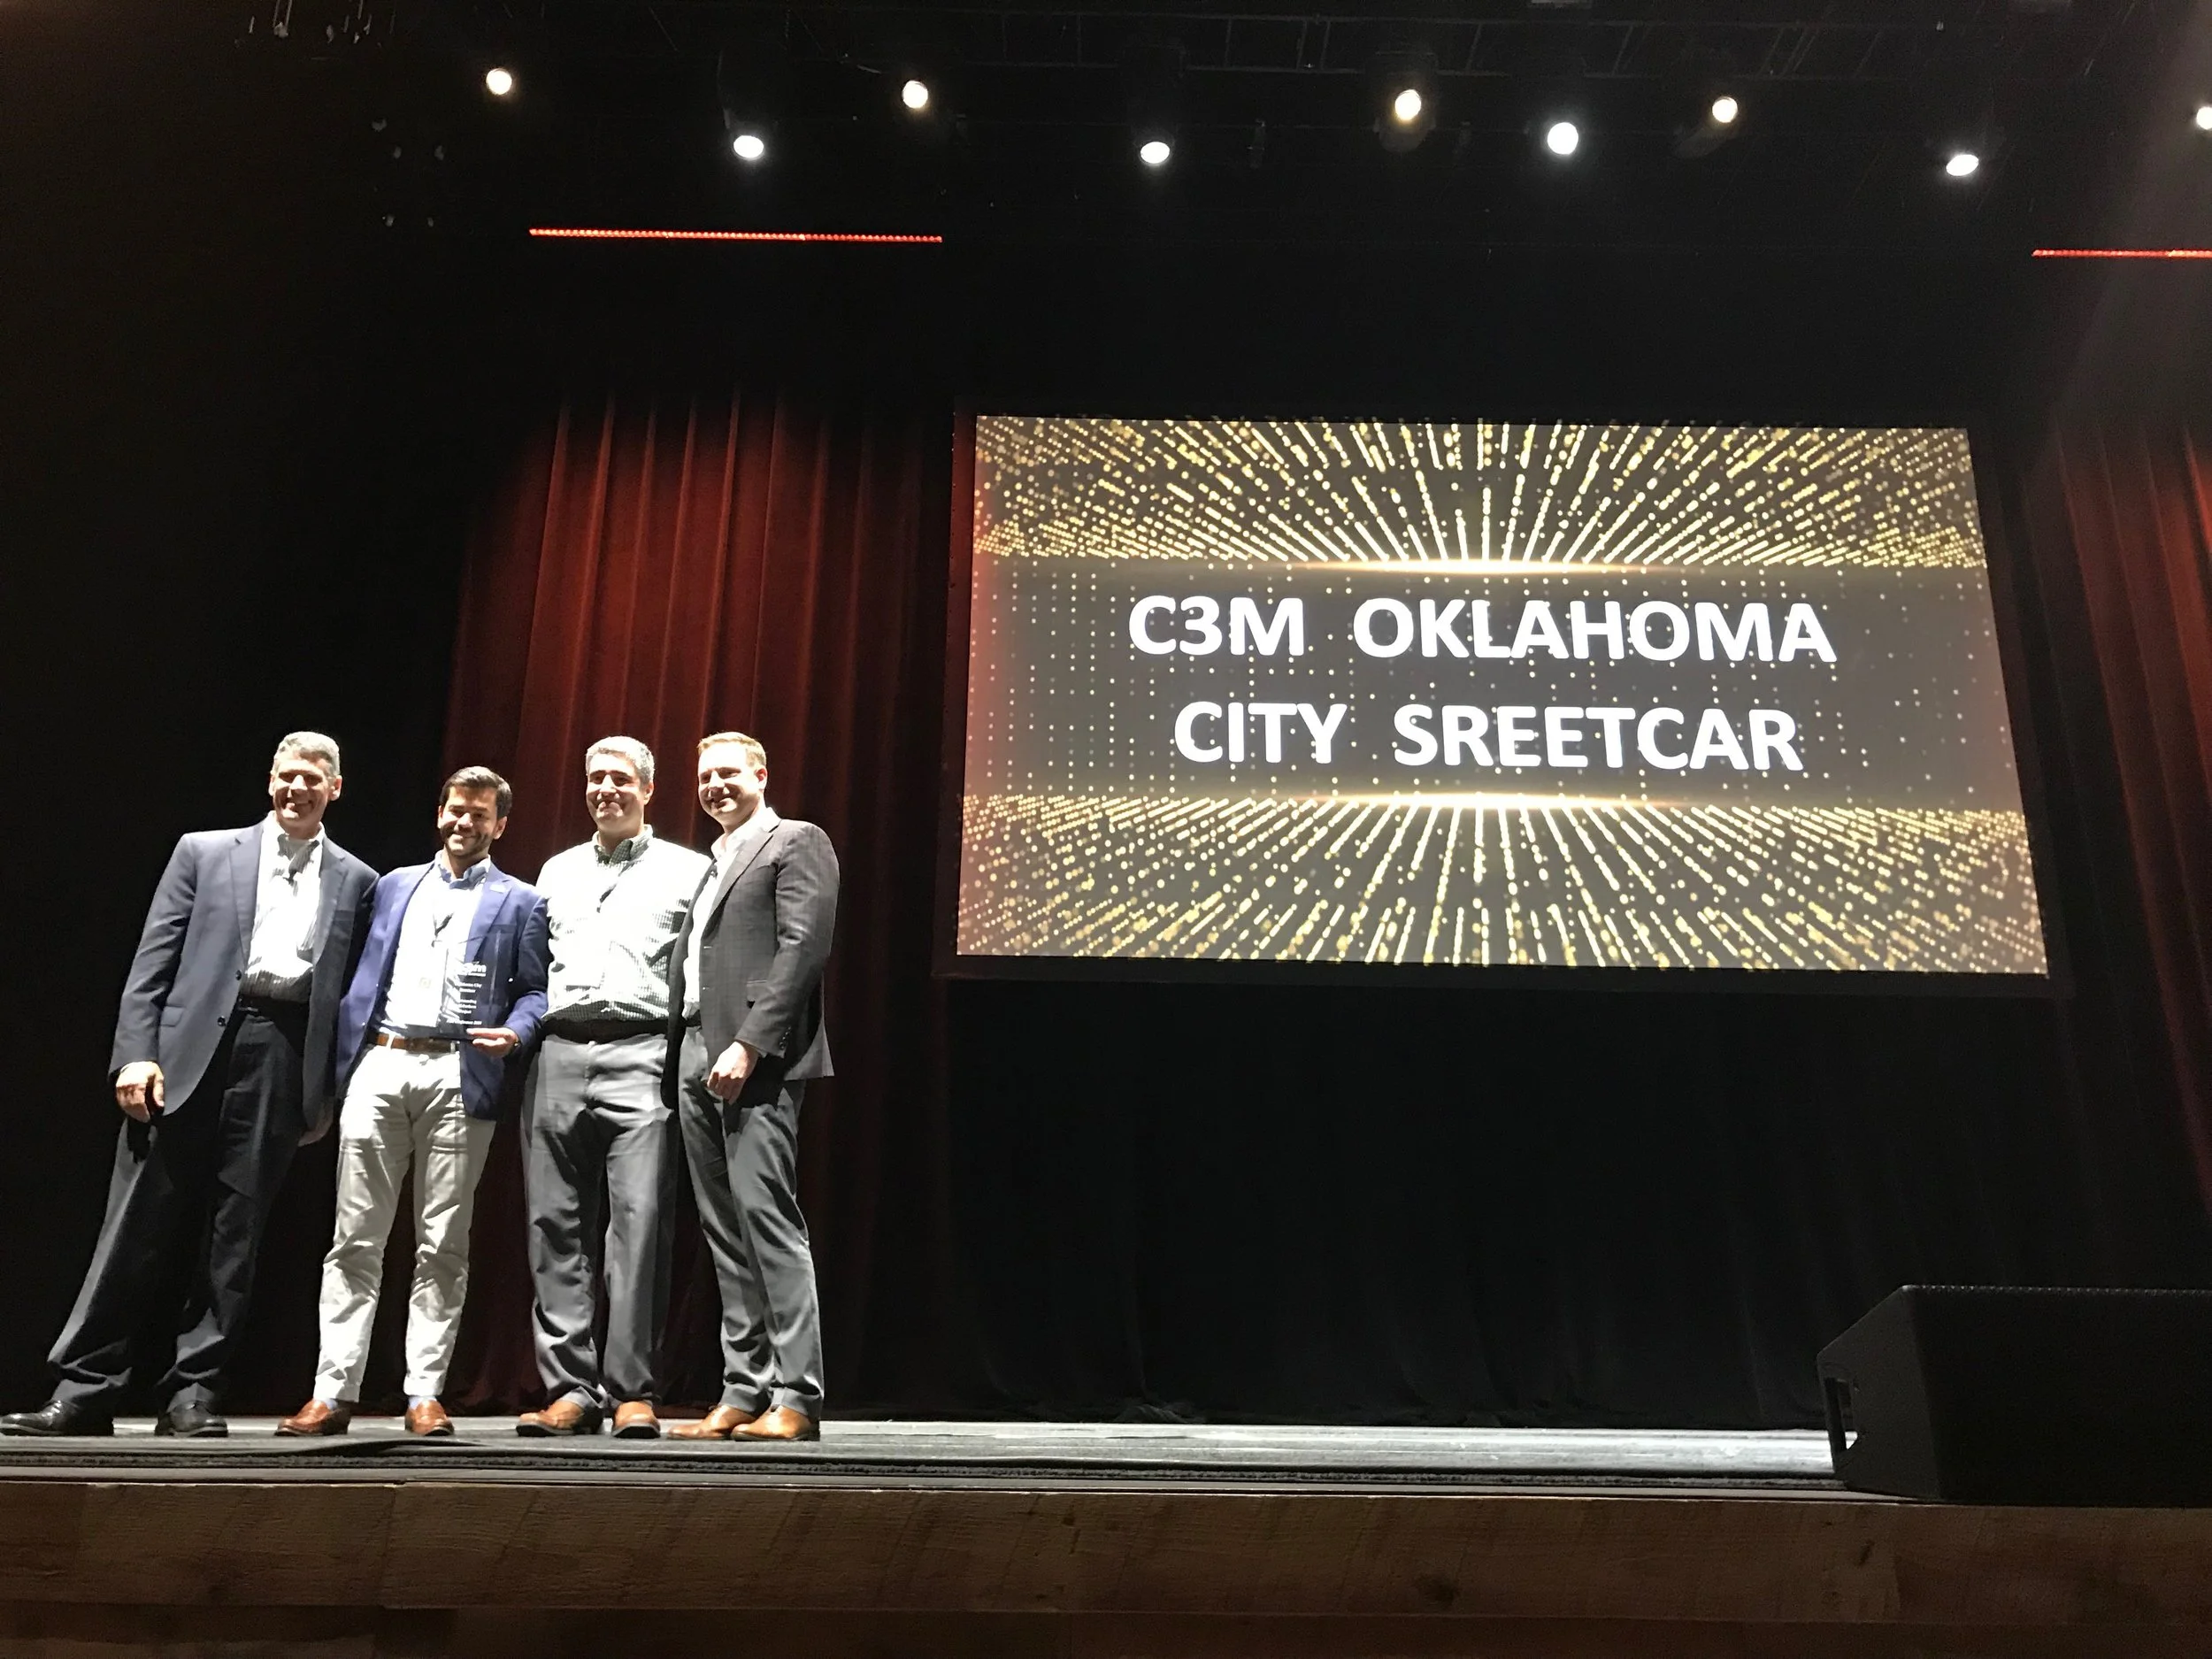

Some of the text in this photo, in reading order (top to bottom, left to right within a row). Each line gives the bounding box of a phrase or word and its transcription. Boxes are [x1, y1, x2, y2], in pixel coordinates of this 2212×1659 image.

[1129, 595, 1838, 663] C3M OKLAHOMA
[1174, 701, 1803, 771] CITY SREETCAR
